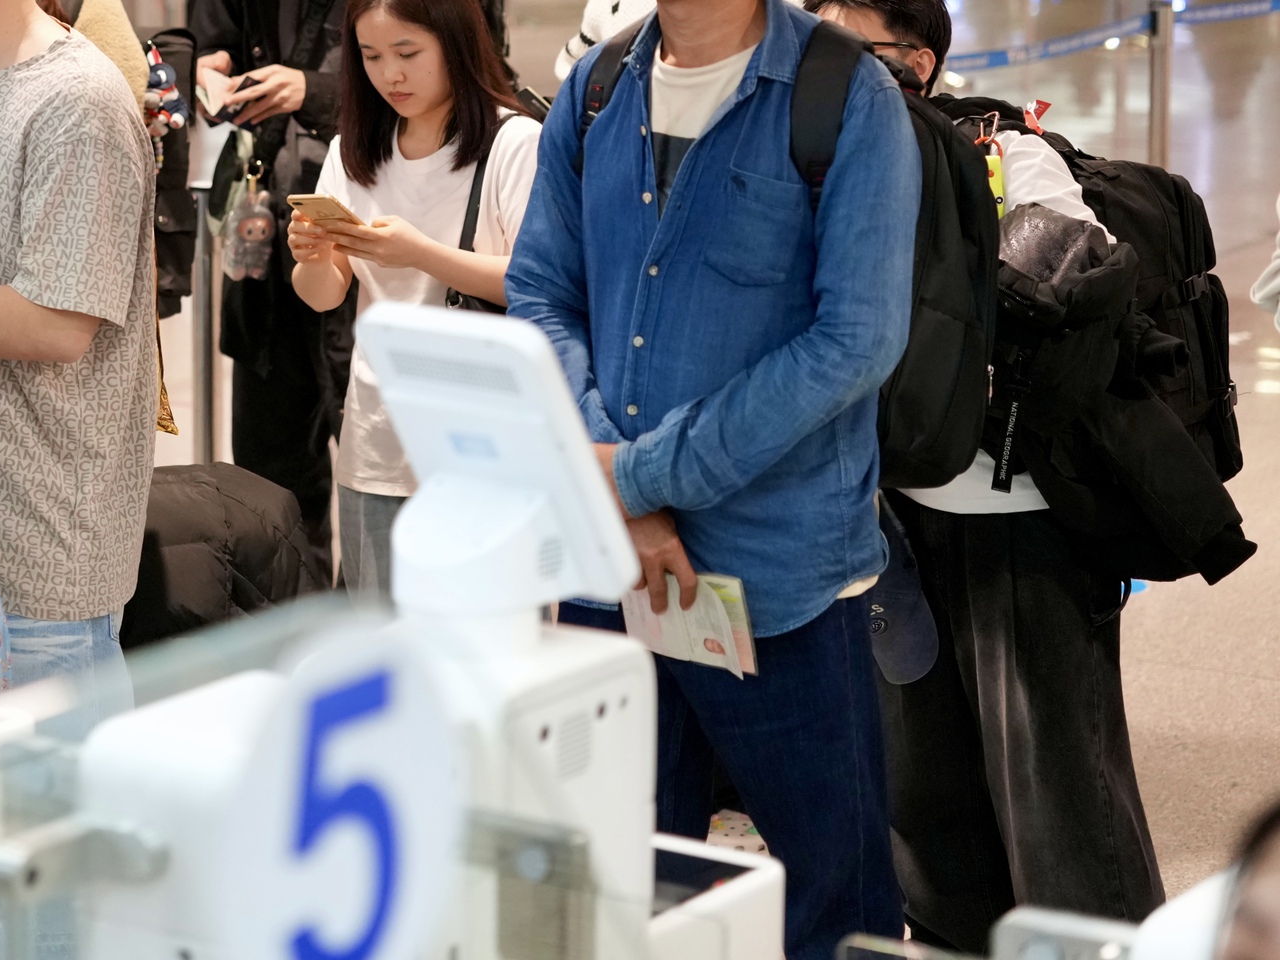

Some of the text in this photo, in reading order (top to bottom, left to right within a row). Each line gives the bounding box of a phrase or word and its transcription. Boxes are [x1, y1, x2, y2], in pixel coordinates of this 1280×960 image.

[999, 401, 1019, 481] NATIONAL GEOGRAPHIC
[291, 667, 395, 960] 5
